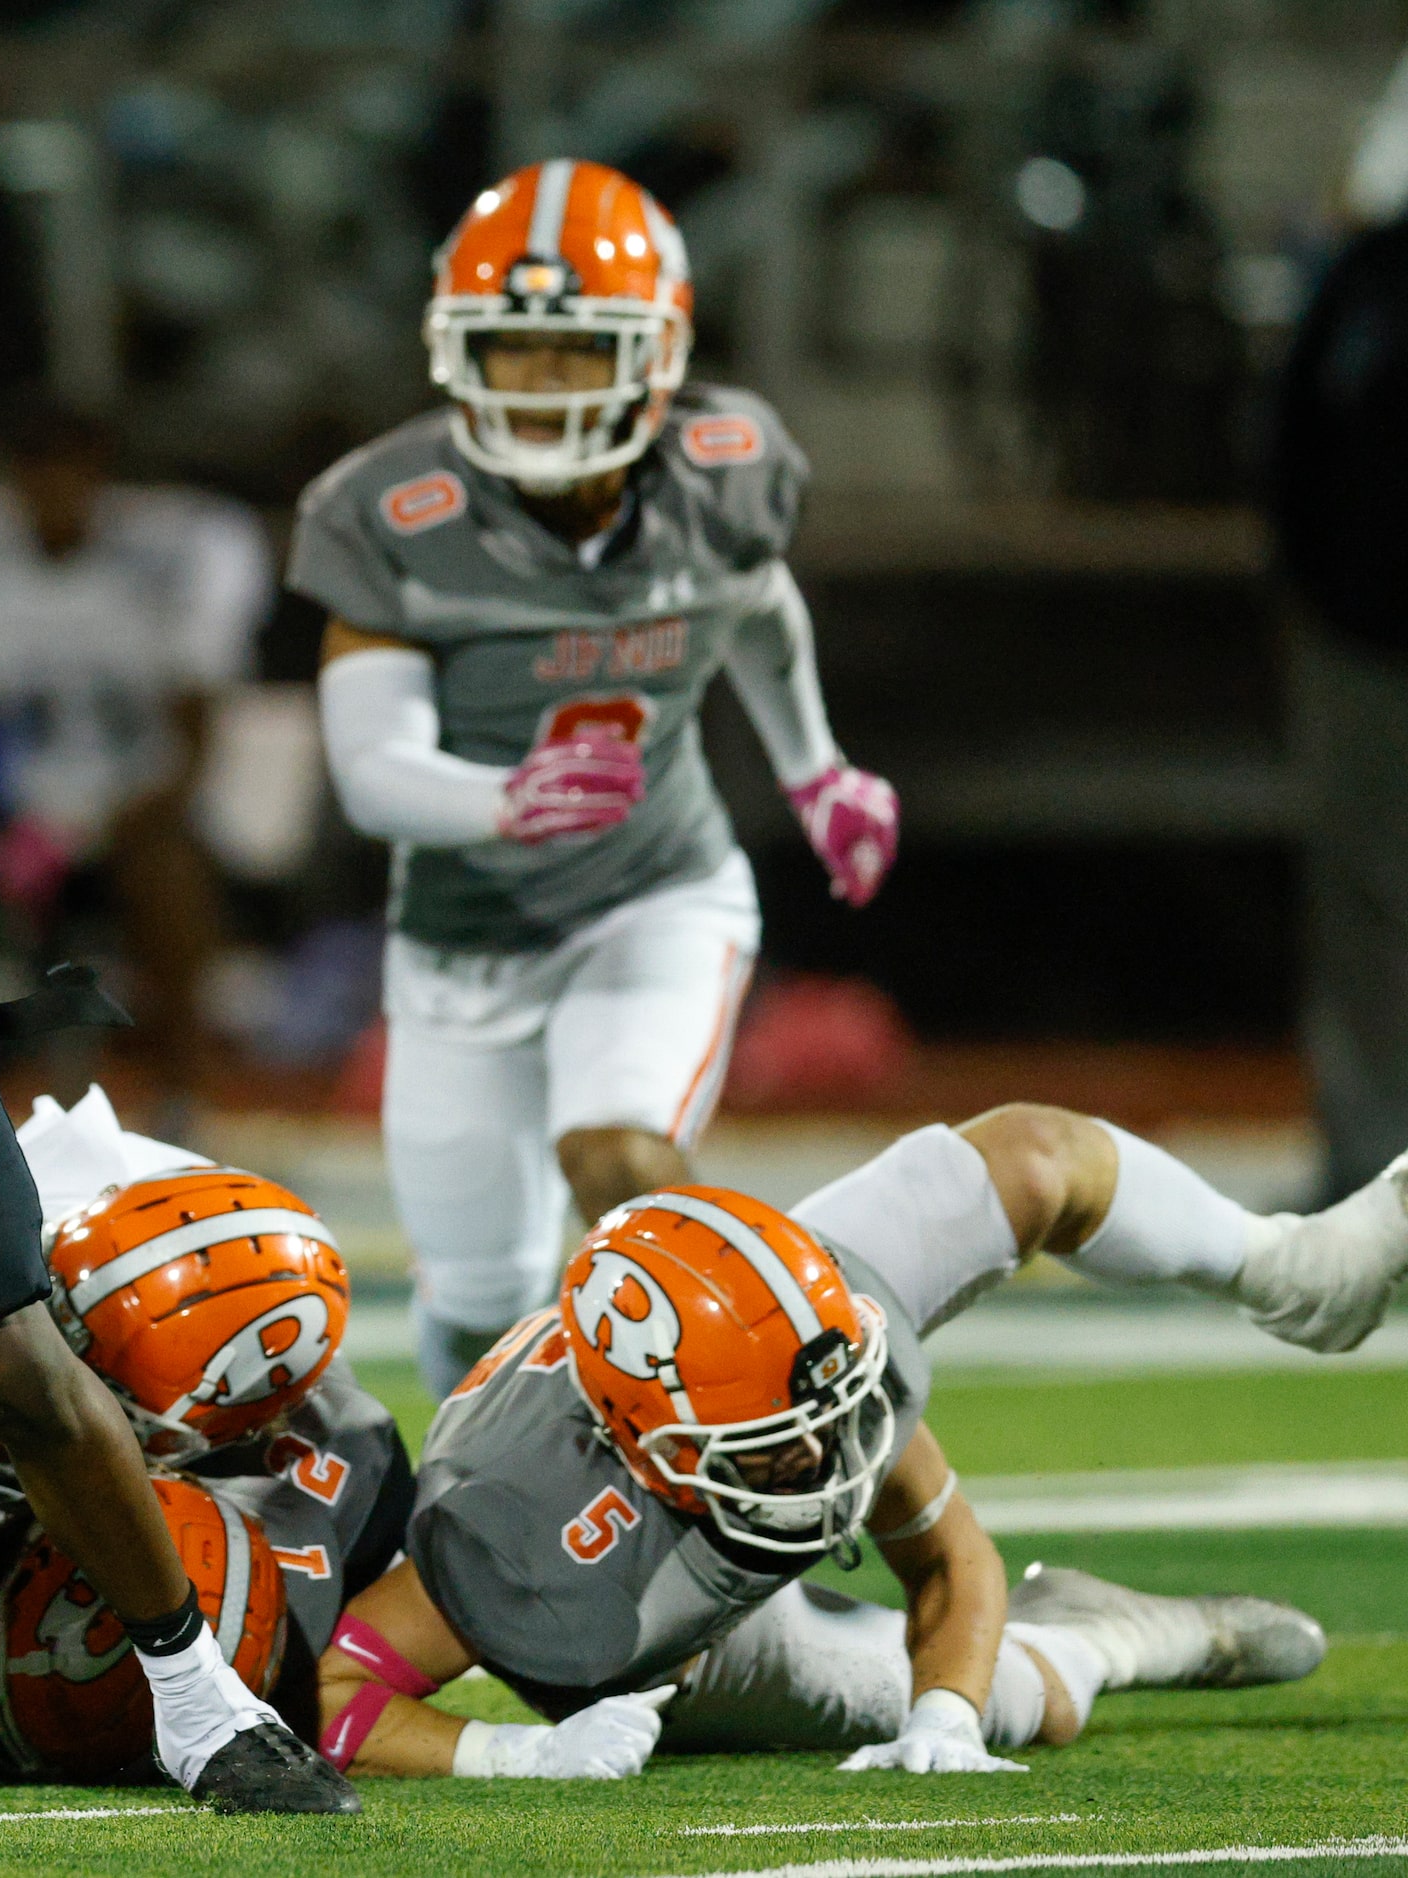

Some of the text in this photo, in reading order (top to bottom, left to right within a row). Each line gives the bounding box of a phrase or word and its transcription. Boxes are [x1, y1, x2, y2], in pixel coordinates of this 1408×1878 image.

[681, 414, 763, 466] 0
[379, 470, 467, 534] 0
[201, 1293, 331, 1407] R
[571, 1249, 682, 1381] R
[263, 1431, 352, 1507] 2
[561, 1485, 643, 1565] 5
